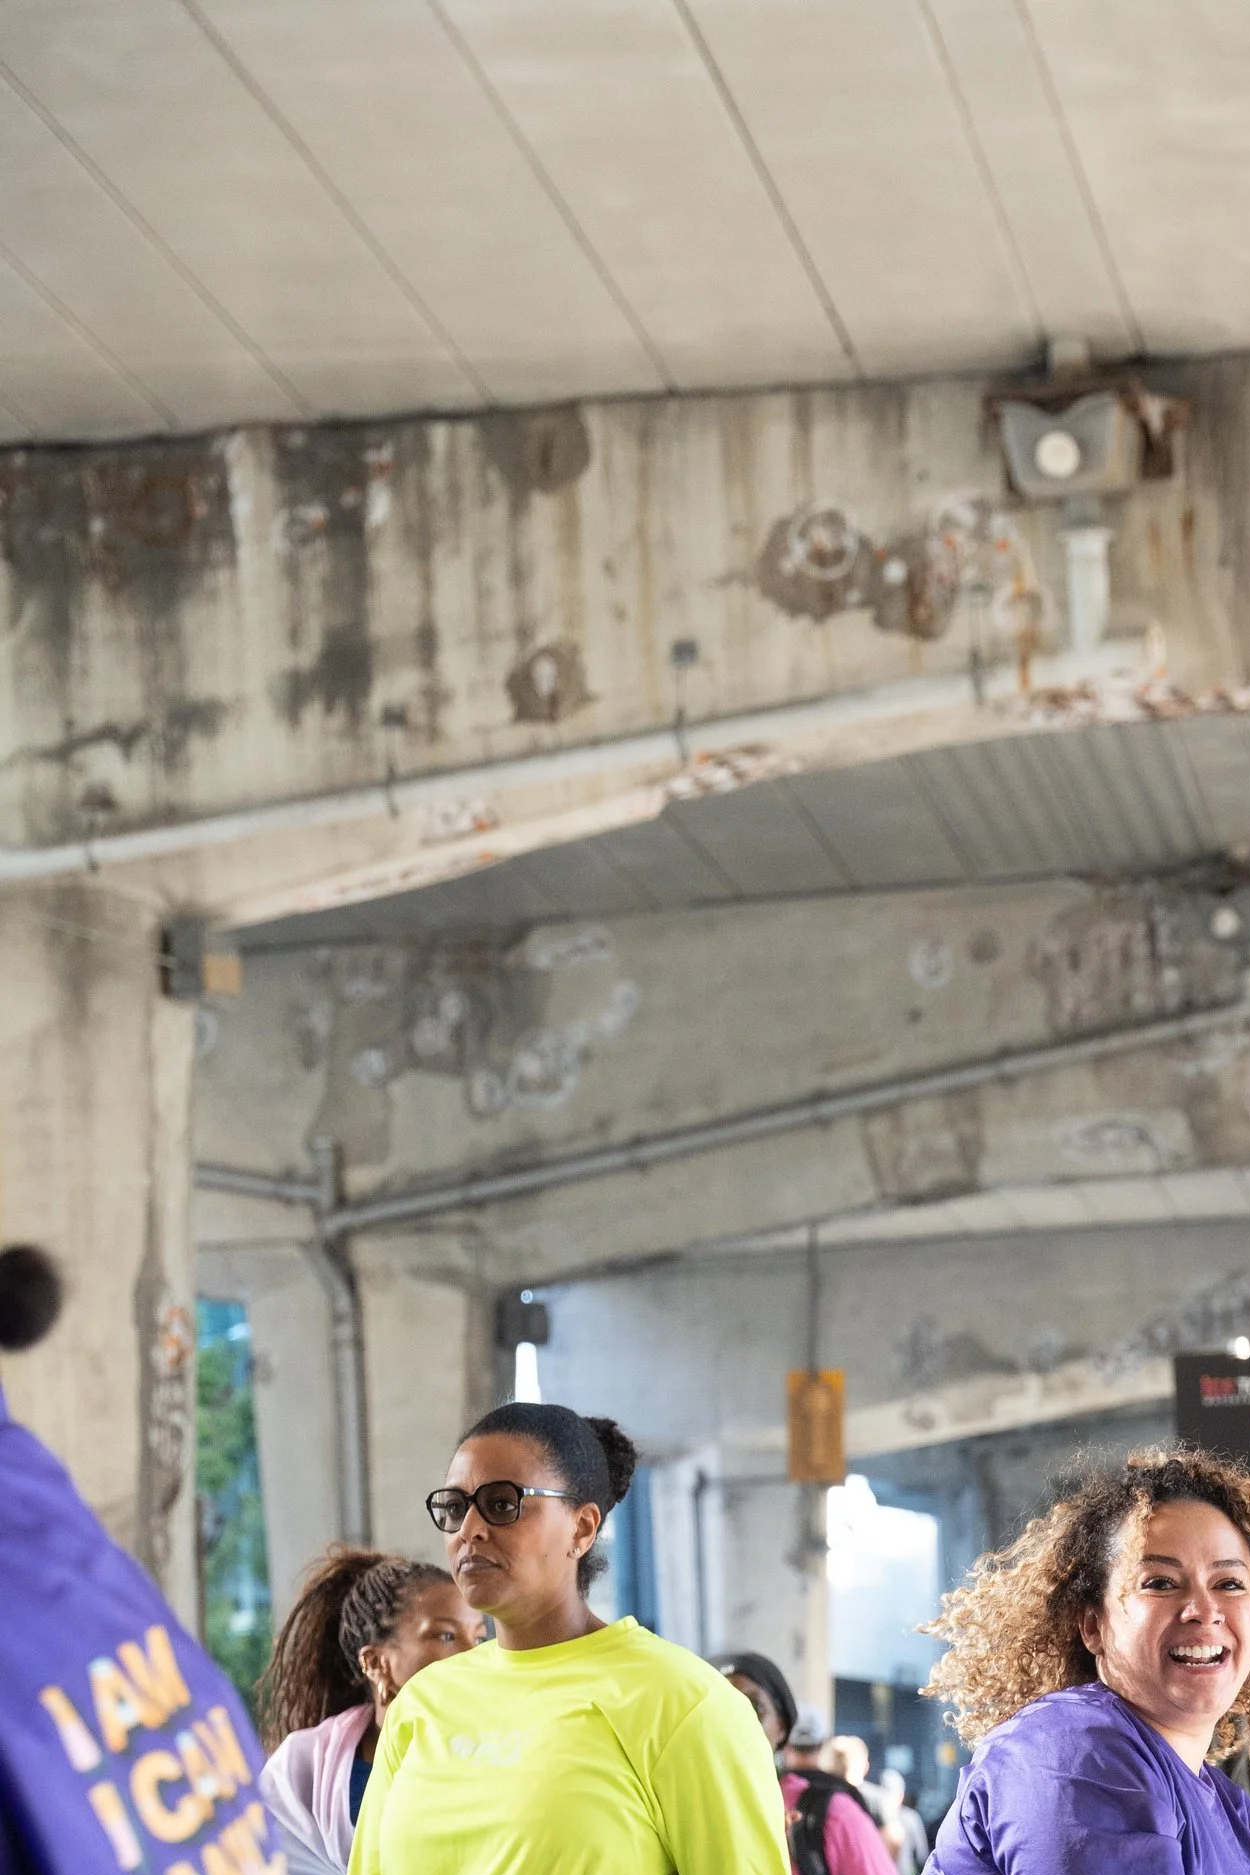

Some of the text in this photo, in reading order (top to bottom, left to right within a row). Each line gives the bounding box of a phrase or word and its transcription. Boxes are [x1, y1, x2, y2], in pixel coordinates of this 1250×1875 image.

[39, 1625, 192, 1773] I AM
[88, 1705, 252, 1872] I CAN
